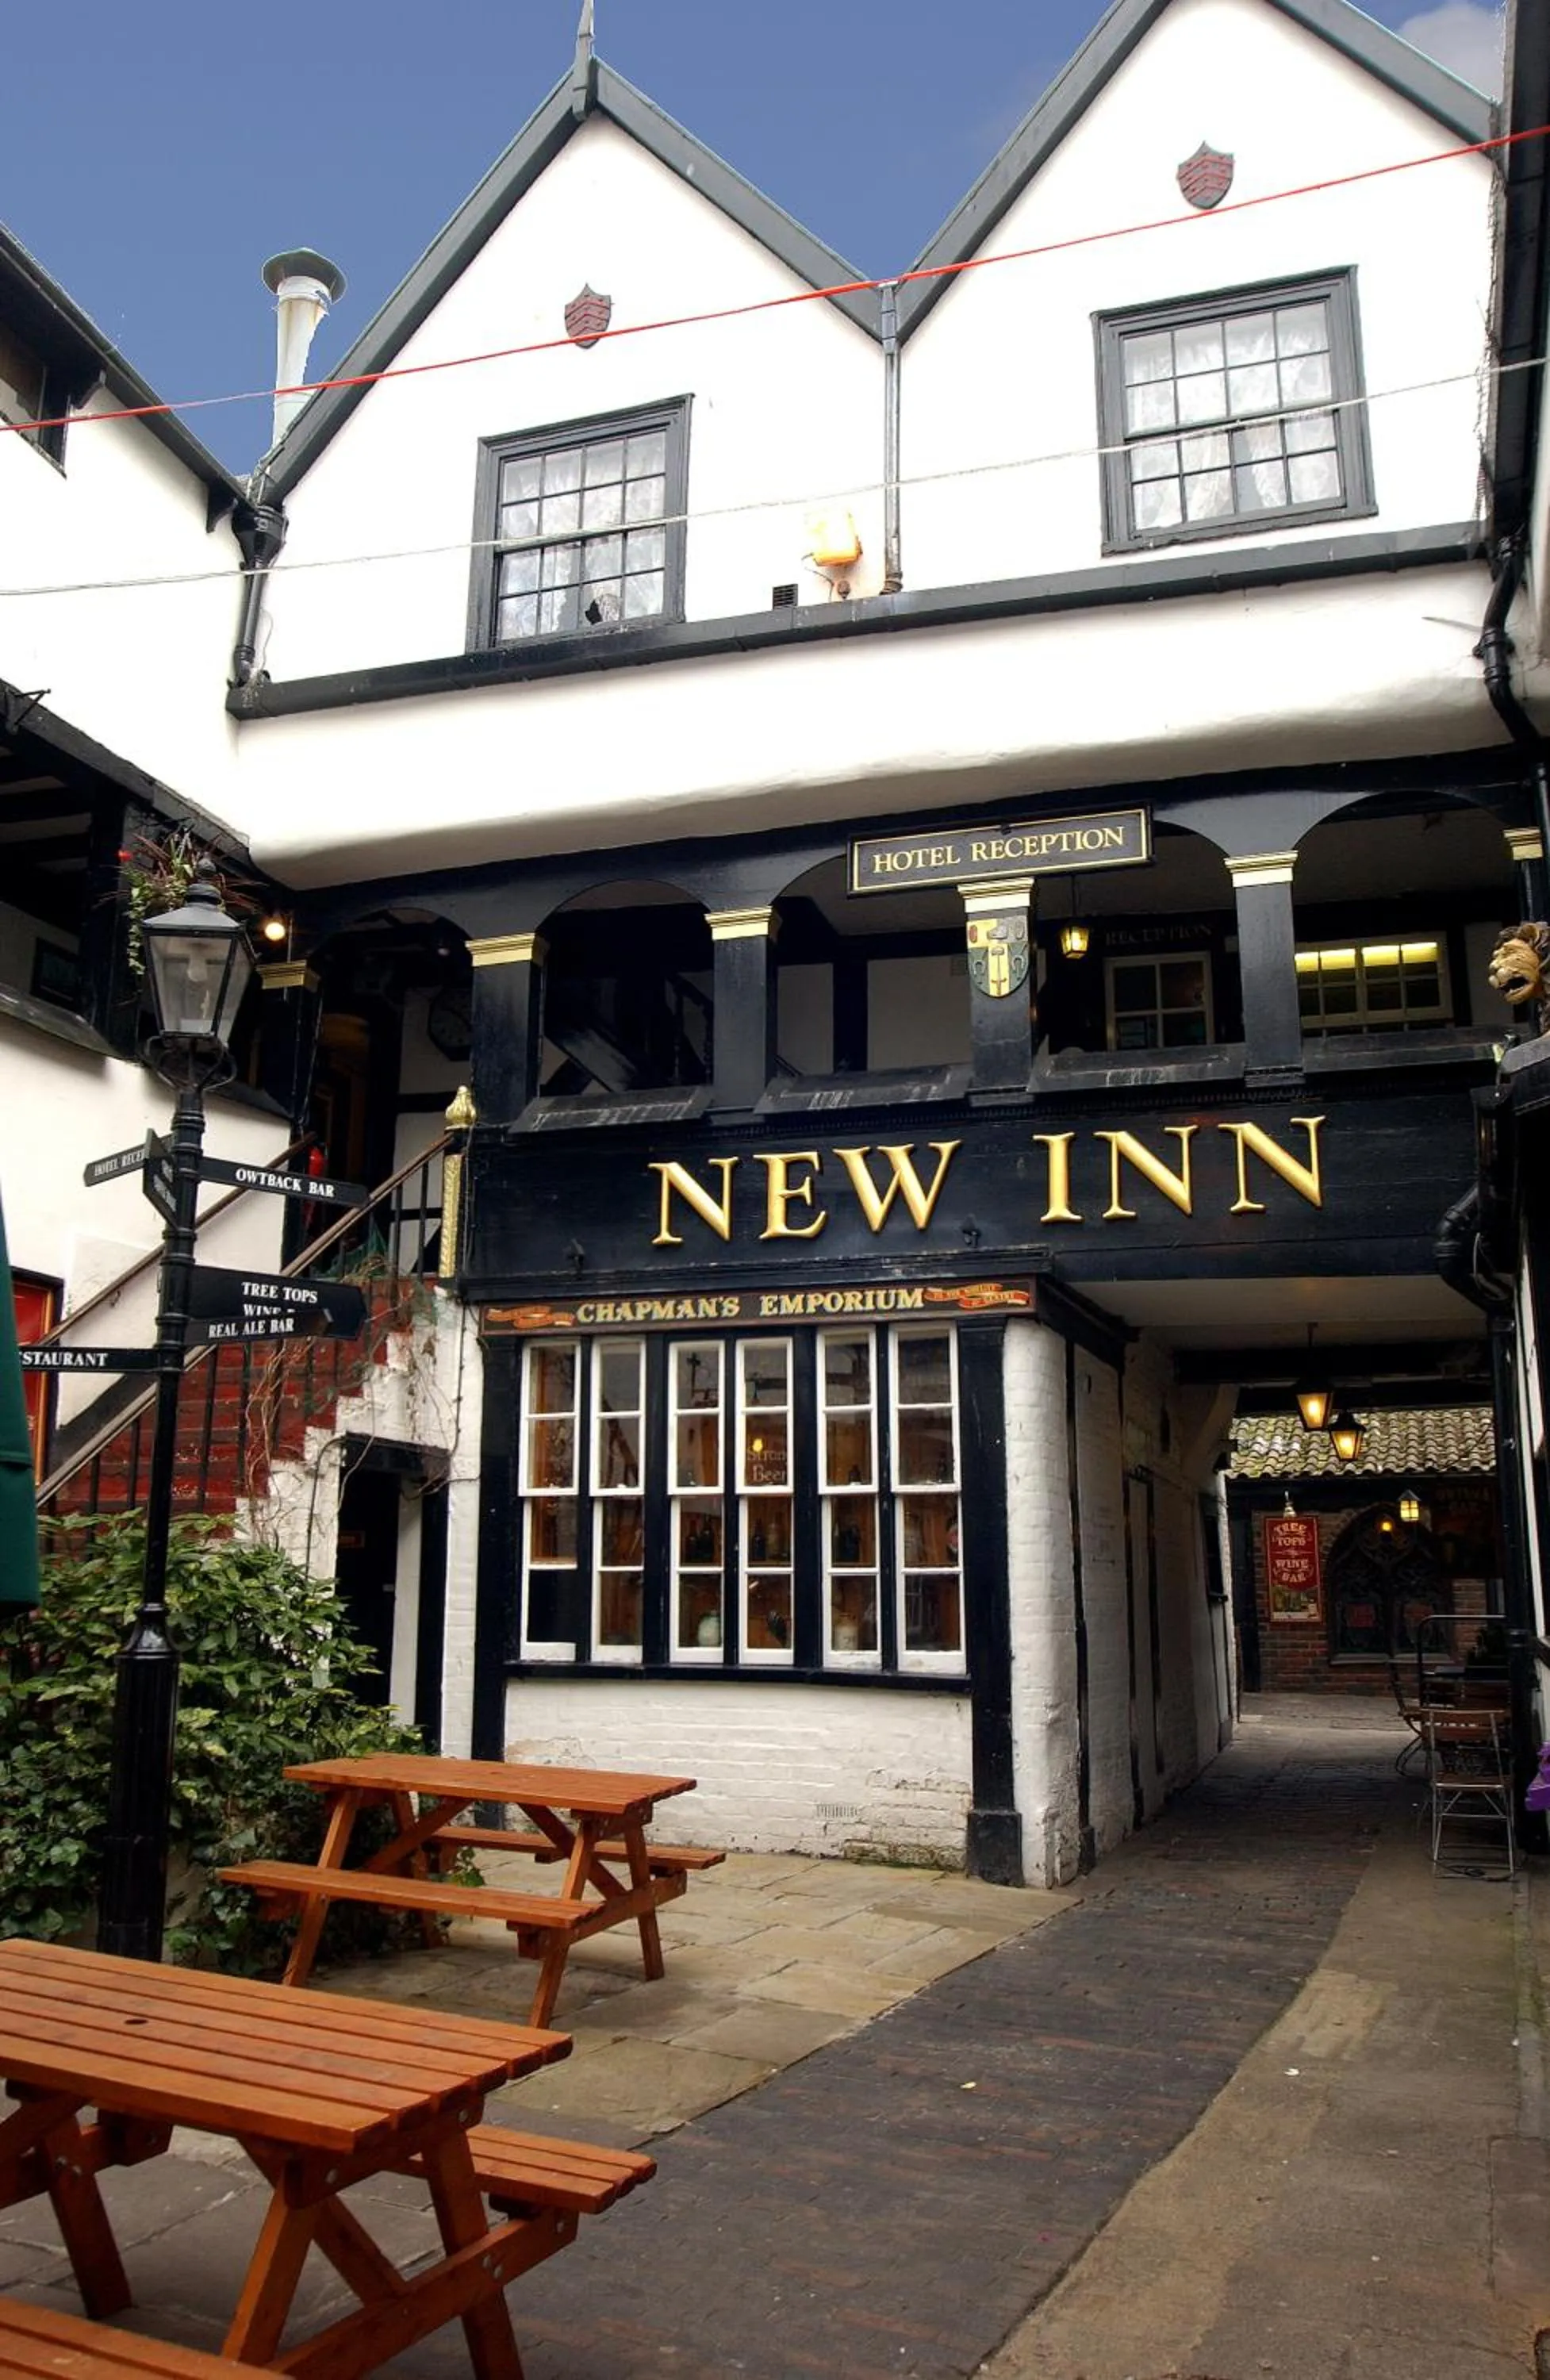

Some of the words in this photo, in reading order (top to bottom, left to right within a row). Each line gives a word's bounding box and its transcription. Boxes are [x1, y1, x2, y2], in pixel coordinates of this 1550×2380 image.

[873, 846, 961, 873] HOTEL
[971, 826, 1125, 862] RECEPTION
[94, 1157, 118, 1177] HOTEL
[236, 1168, 301, 1192] OWTBACK
[309, 1181, 334, 1197] BAR
[647, 1138, 962, 1246] NEW
[1032, 1114, 1327, 1223] INN
[241, 1281, 278, 1299] TREE
[282, 1286, 318, 1303] TOPS
[576, 1296, 740, 1324] CHAPMAN'S
[760, 1288, 925, 1317] EMPORIUM
[209, 1323, 238, 1339] REAL
[242, 1320, 266, 1336] ALE
[270, 1318, 294, 1334] BAR
[19, 1350, 109, 1367] STAURANT
[1275, 1559, 1309, 1568] WINE
